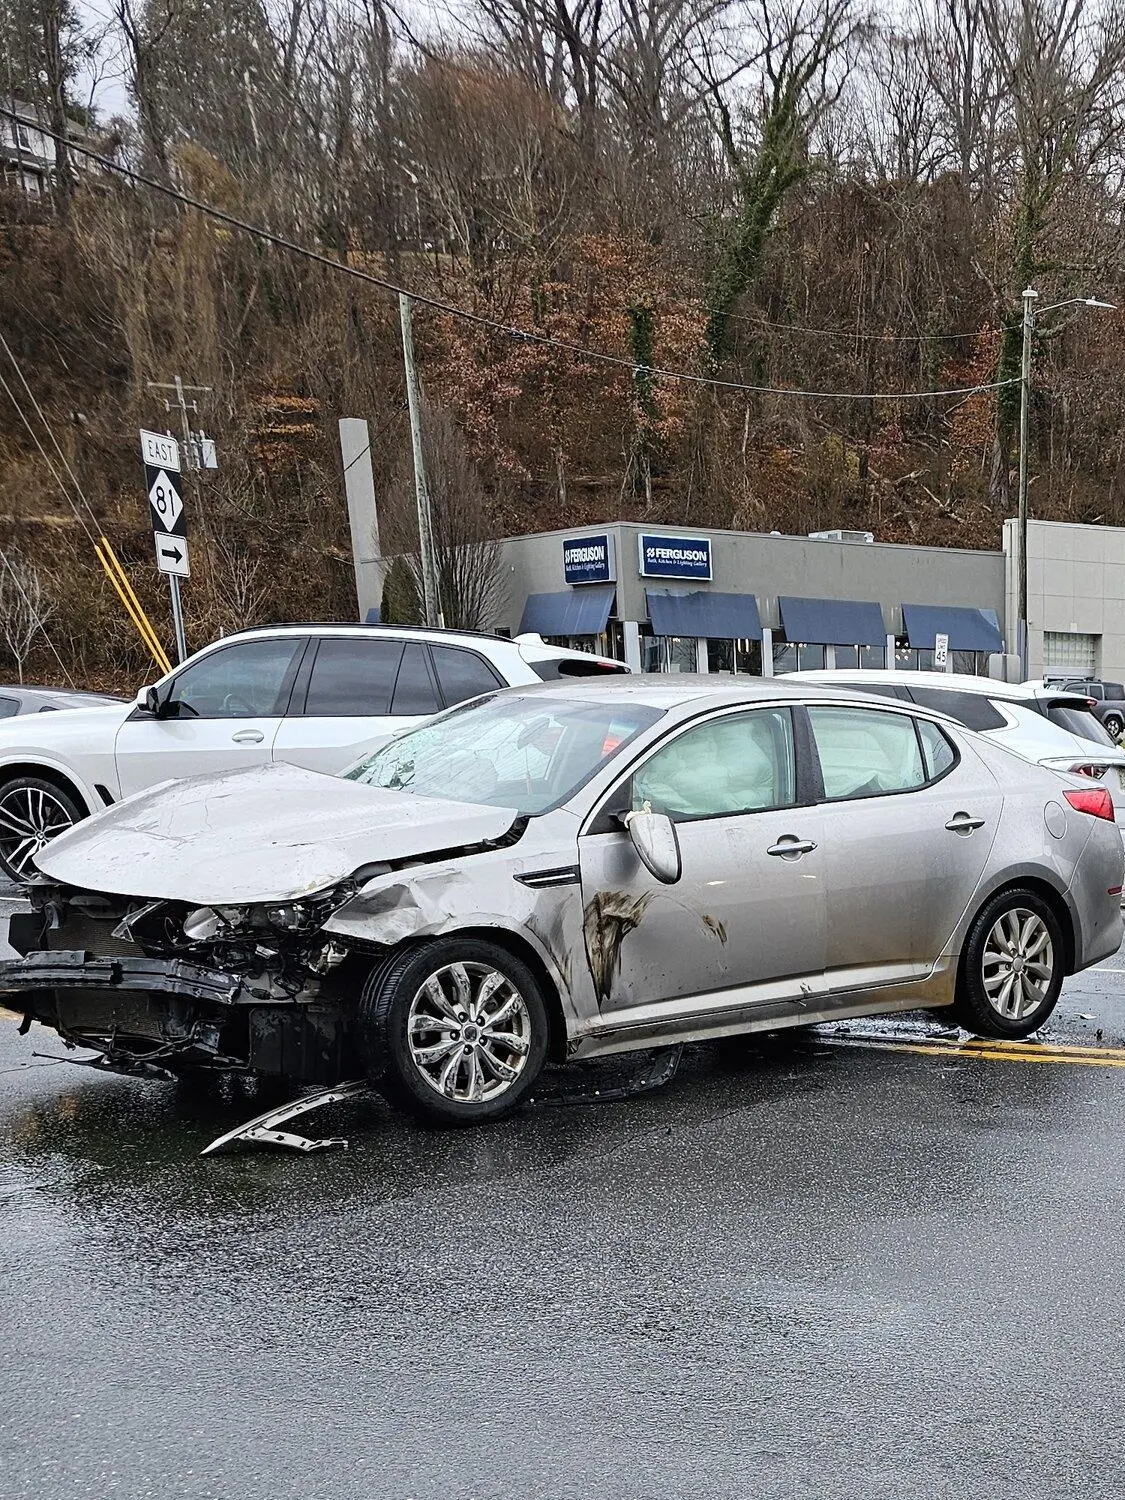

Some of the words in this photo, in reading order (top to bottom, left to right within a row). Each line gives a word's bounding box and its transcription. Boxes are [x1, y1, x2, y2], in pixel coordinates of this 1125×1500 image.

[148, 440, 172, 462] EAST
[156, 486, 175, 516] 81
[570, 546, 604, 563] FERGUSON
[656, 548, 708, 562] FERGUSON
[936, 651, 946, 662] 45
